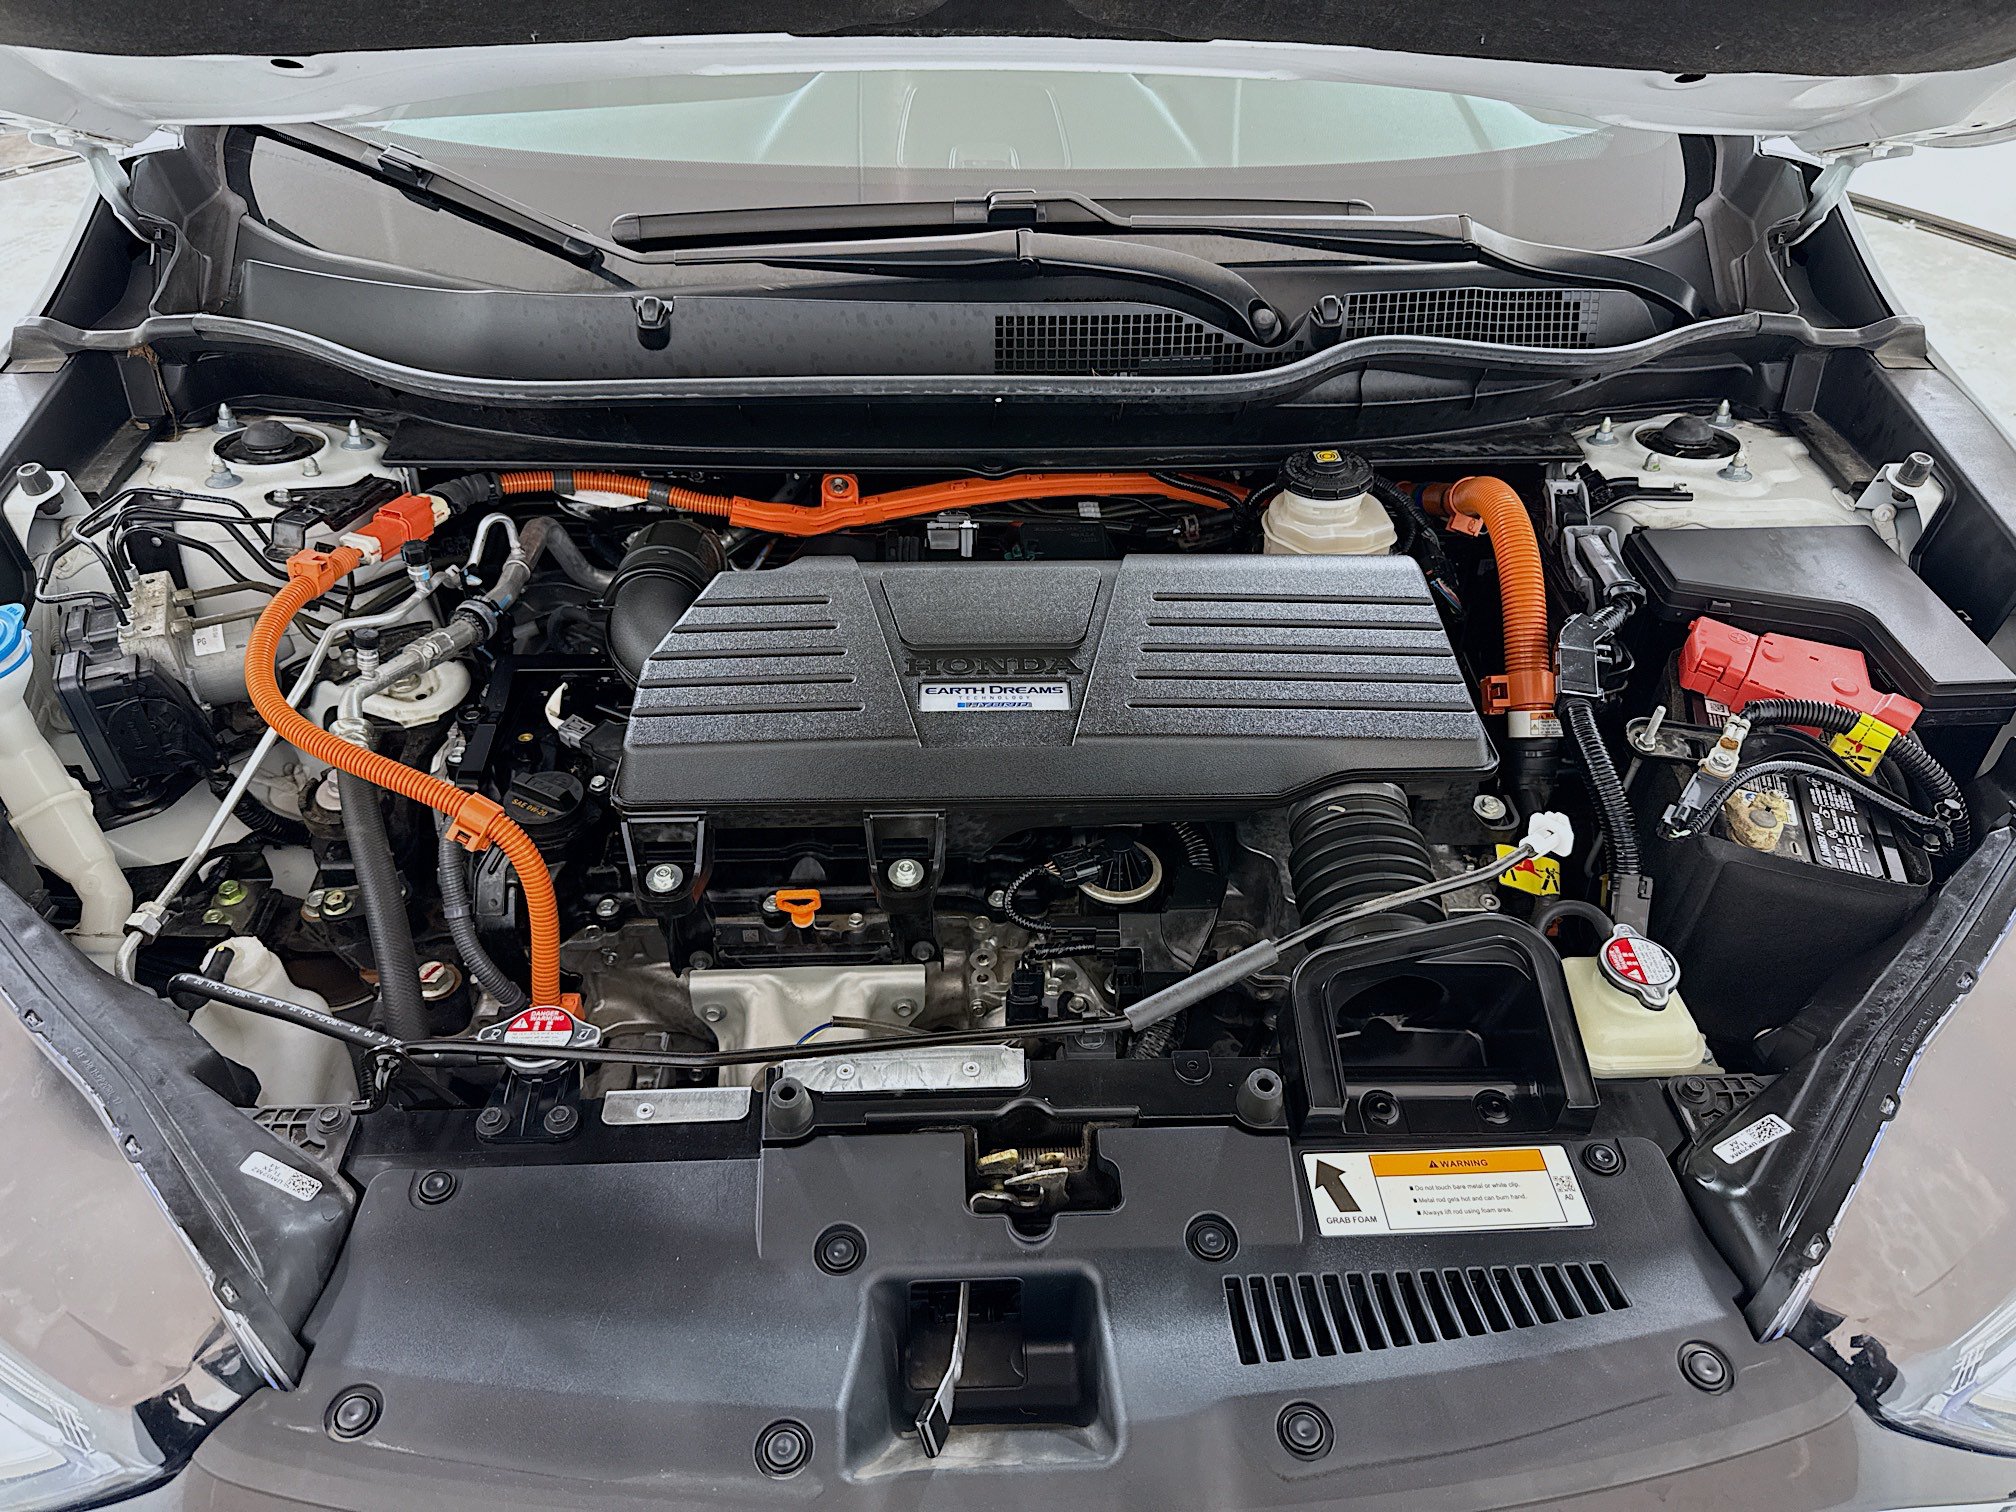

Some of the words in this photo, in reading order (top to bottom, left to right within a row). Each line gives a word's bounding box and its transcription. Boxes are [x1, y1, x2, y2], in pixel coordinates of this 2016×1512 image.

[904, 657, 1083, 676] HONDA
[925, 687, 985, 695] EARTH
[990, 685, 1064, 695] DREAMS
[511, 798, 528, 809] SAE
[1440, 1159, 1488, 1168] WARNING
[1492, 1181, 1507, 1189] white
[1326, 1216, 1351, 1224] GRAB
[1352, 1215, 1378, 1224] FOAM
